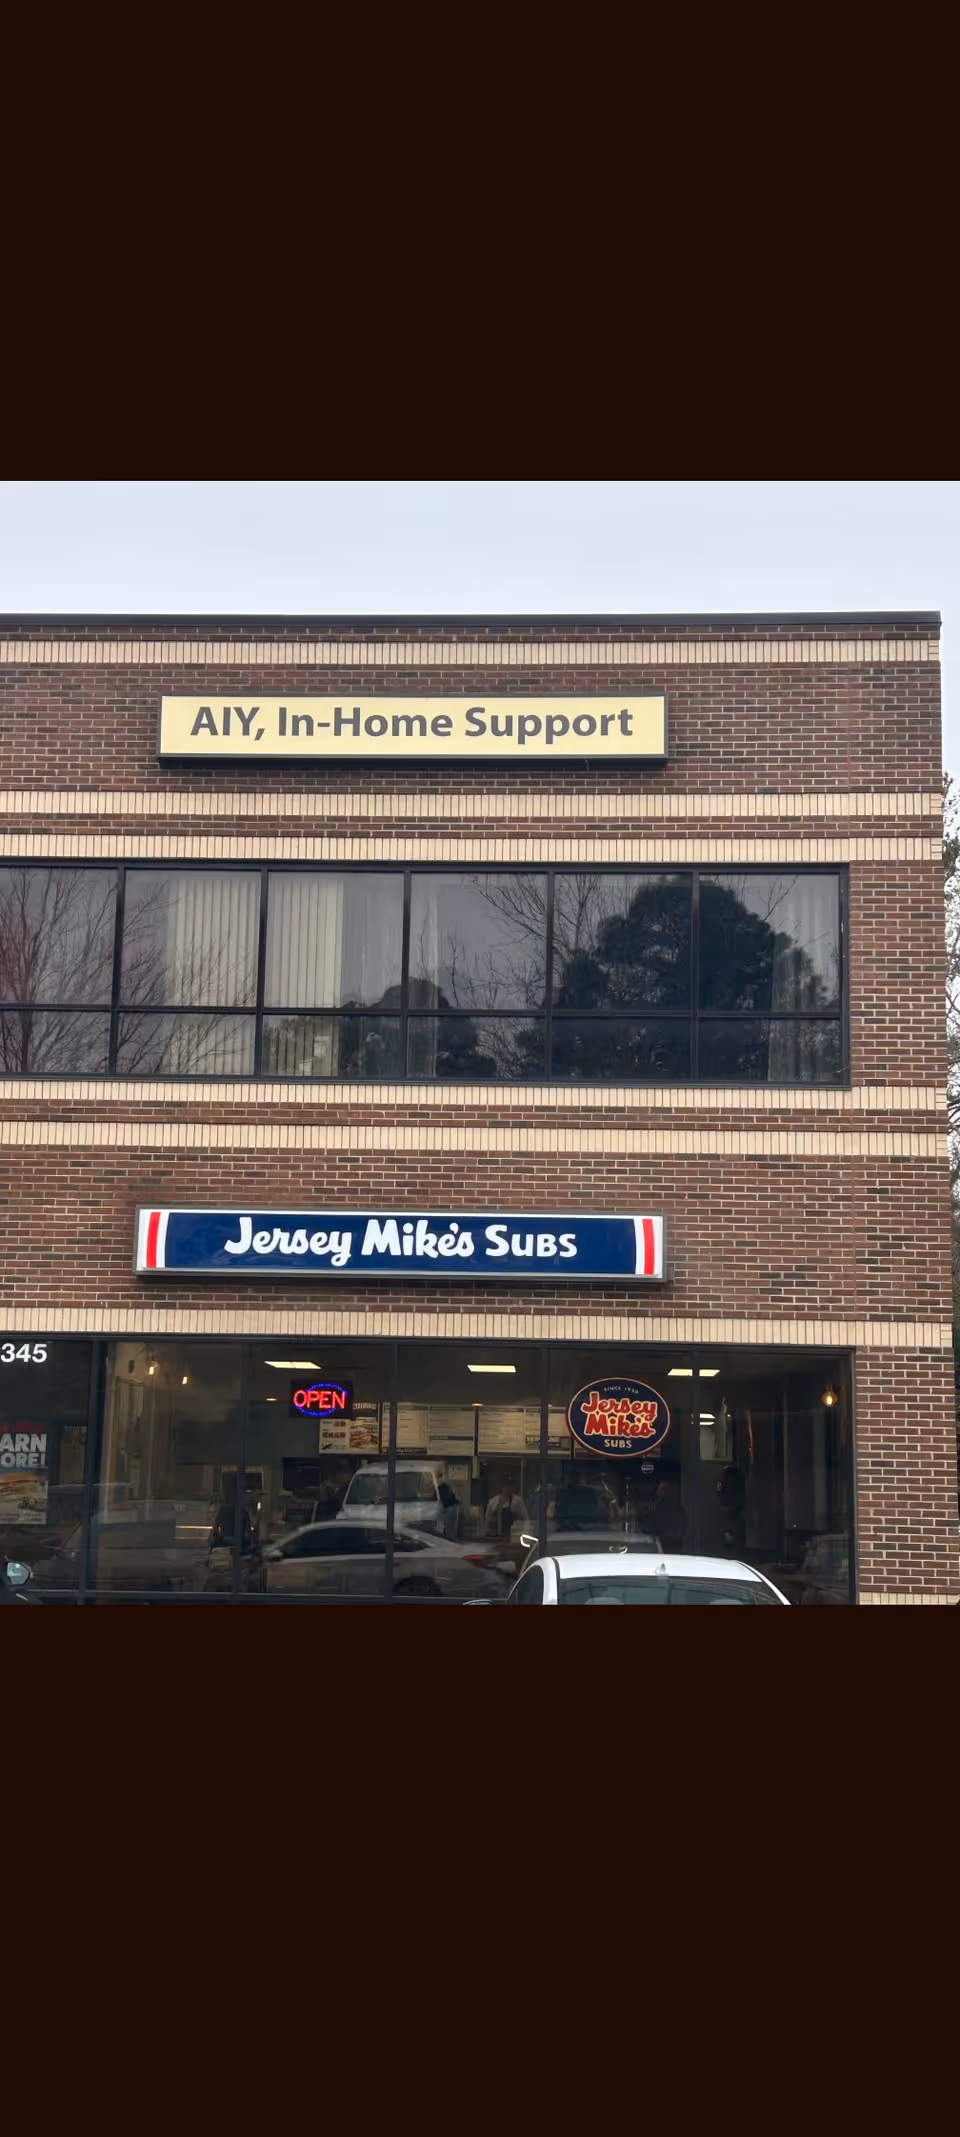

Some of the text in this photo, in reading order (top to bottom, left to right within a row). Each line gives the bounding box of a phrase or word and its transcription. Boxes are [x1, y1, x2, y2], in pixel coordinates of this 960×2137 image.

[190, 706, 634, 745] AIY, In-Home Support
[224, 1216, 578, 1266] Jersey Mike's SUBS
[0, 1342, 48, 1364] 345
[293, 1389, 346, 1409] OPEN
[580, 1391, 658, 1423] Jersey
[584, 1413, 657, 1439] Mike's
[604, 1439, 632, 1449] SUBS
